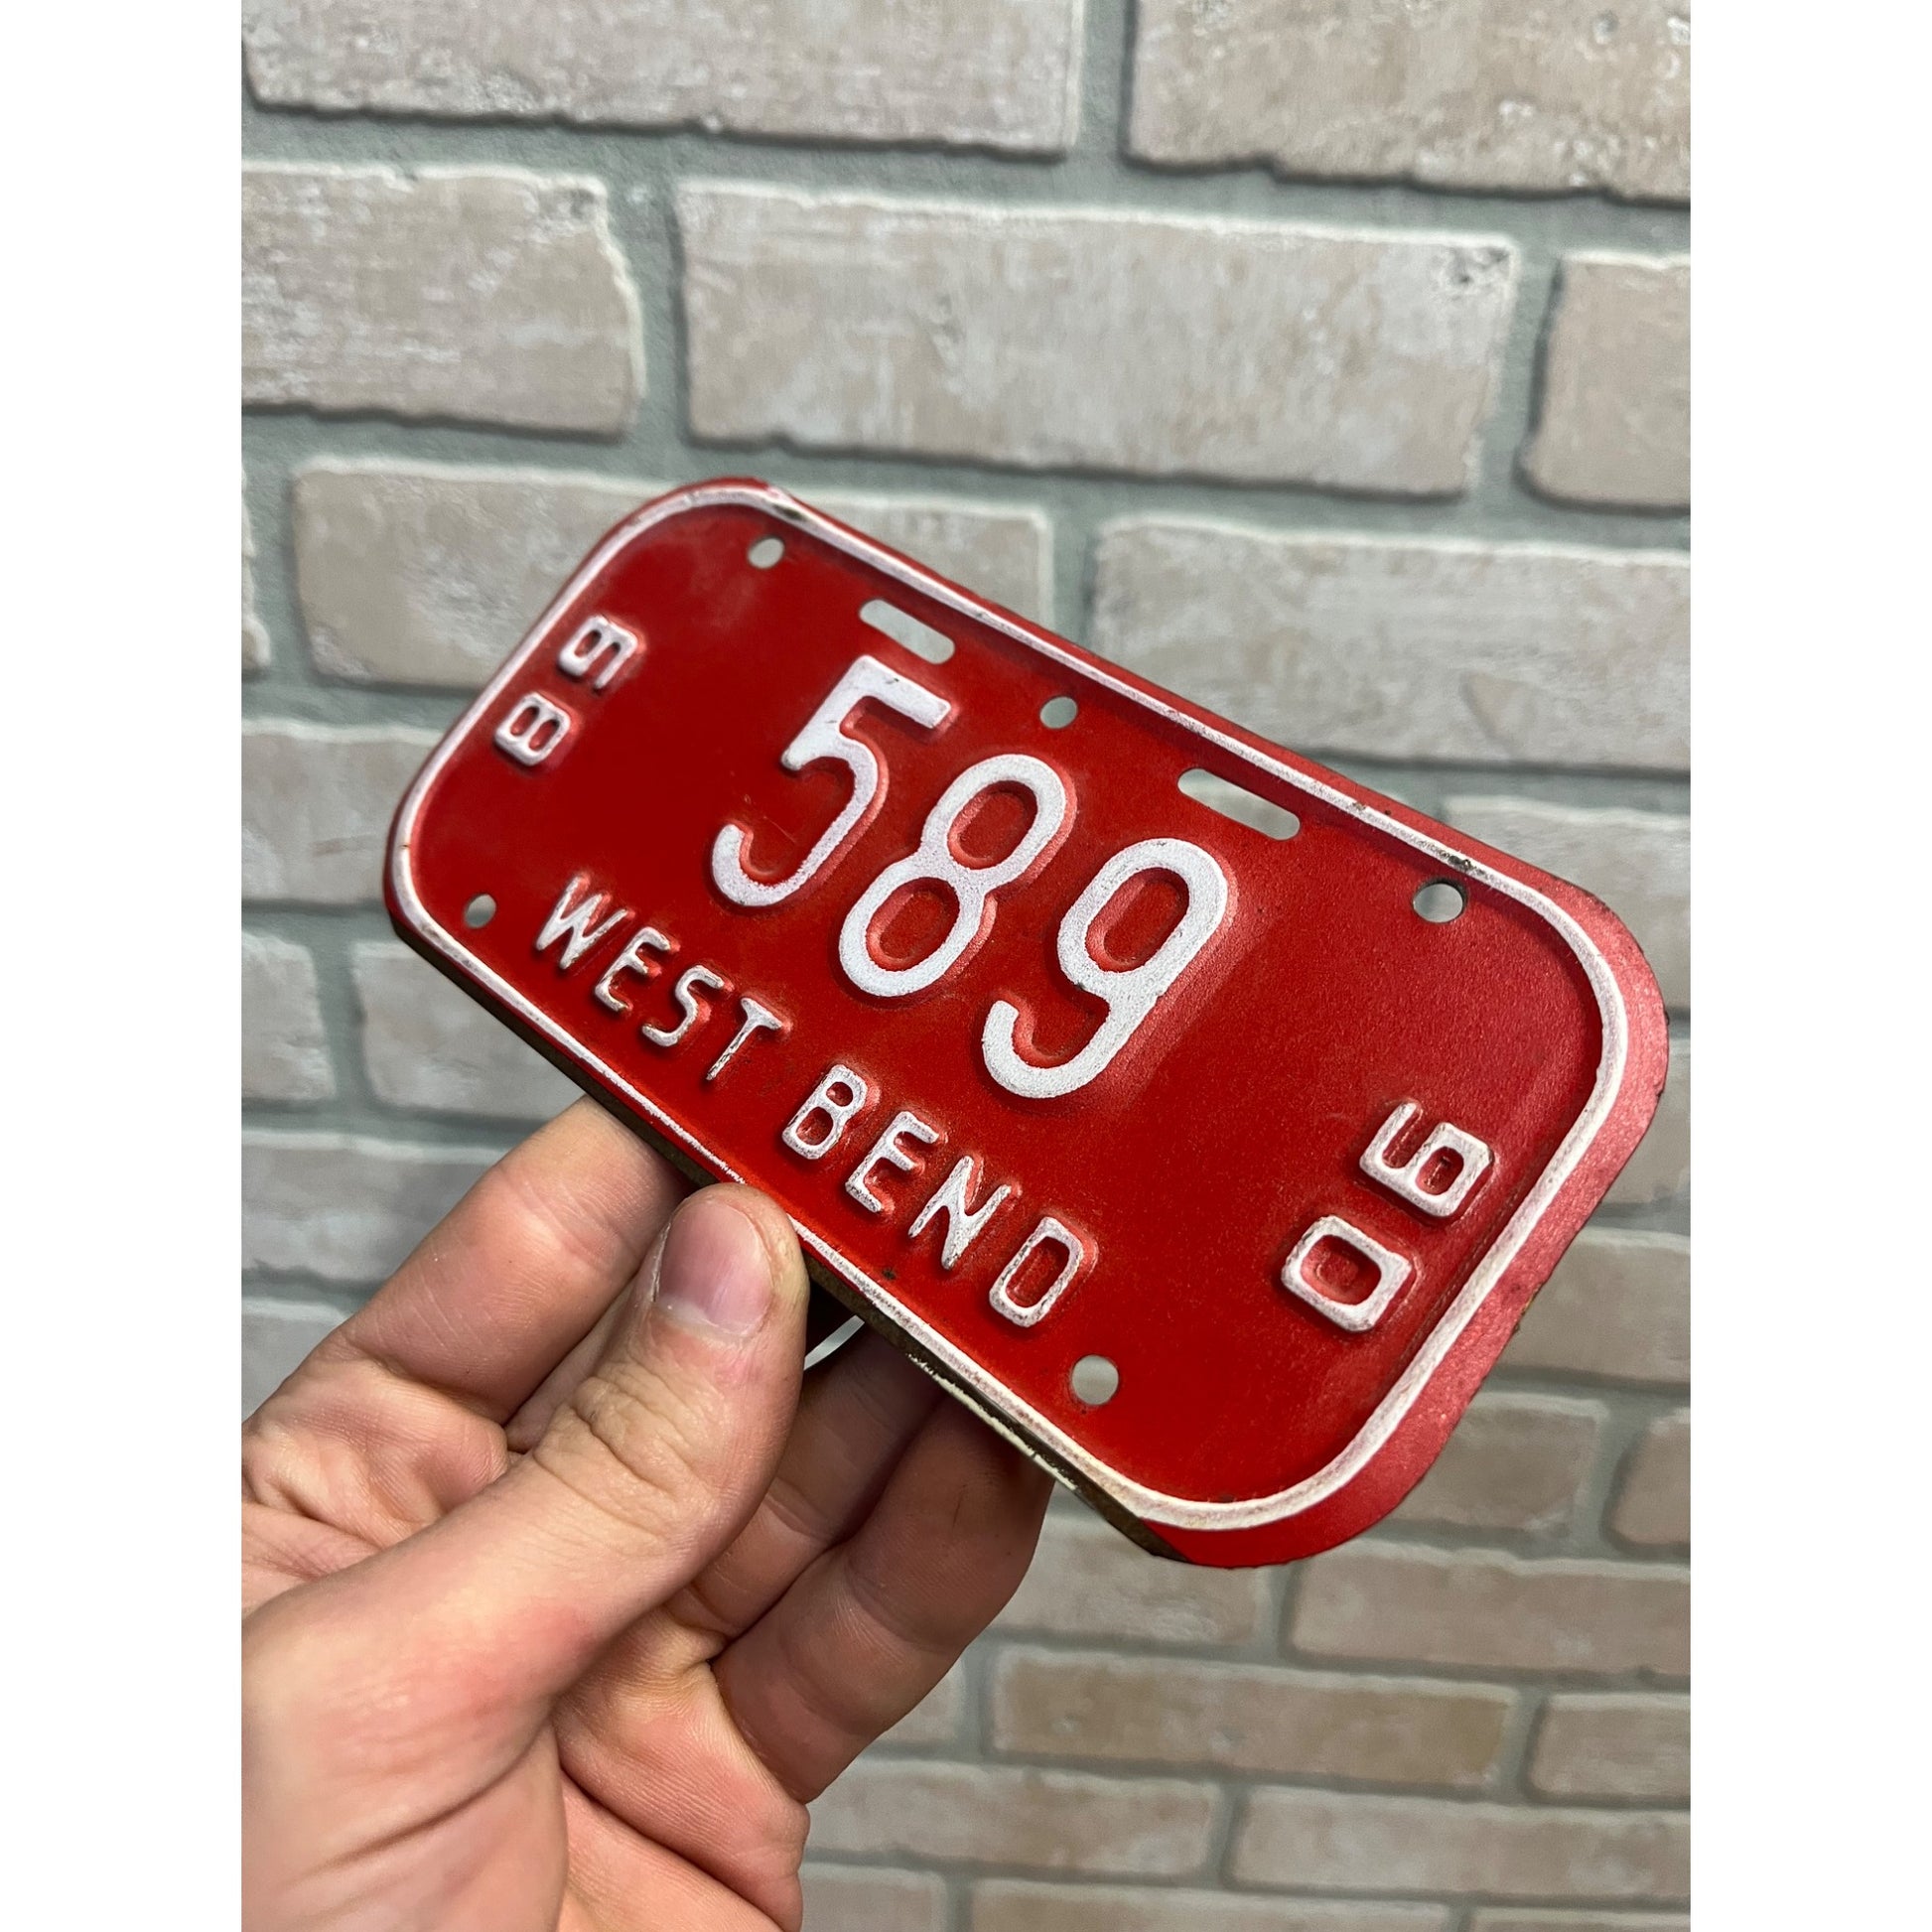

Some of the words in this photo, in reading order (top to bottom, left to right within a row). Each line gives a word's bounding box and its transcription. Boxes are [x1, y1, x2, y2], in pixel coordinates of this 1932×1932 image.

[494, 615, 638, 765] 89
[712, 654, 1229, 1099] 589
[535, 875, 783, 1081] WEST
[782, 1063, 1090, 1329] BEND
[1281, 1102, 1493, 1331] 90
